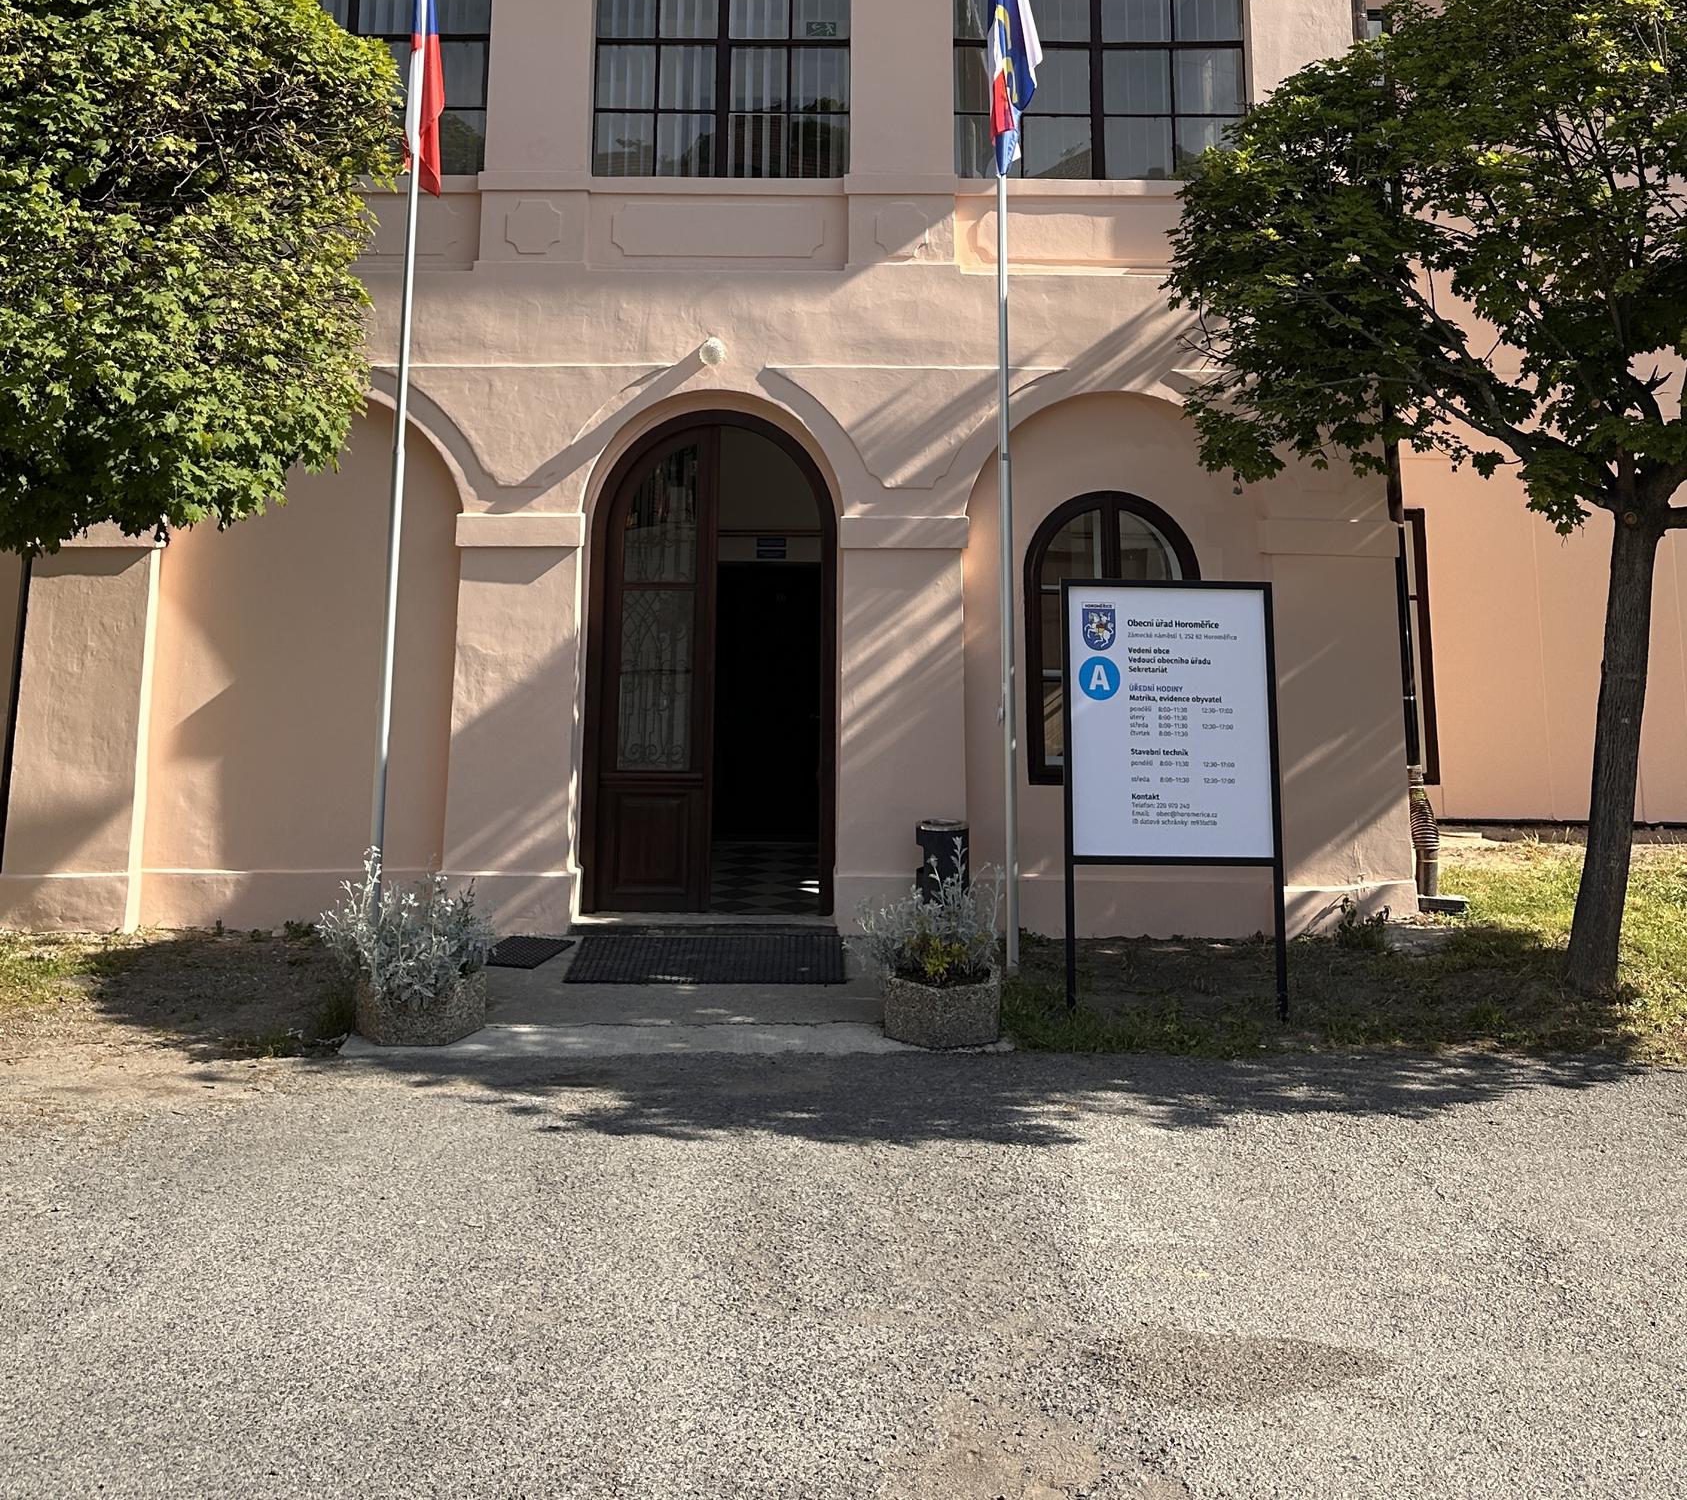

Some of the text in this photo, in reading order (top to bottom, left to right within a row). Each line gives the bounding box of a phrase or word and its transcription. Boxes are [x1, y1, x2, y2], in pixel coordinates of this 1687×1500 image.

[1127, 619, 1219, 629] Obecní úřad Horoměřice
[1191, 657, 1211, 665] úřadu
[1089, 664, 1111, 691] A
[1129, 683, 1155, 692] ÚŘEDNÍ
[1129, 694, 1158, 702] Matrika,
[1191, 695, 1222, 704] obyvatel
[1163, 748, 1189, 756] technik
